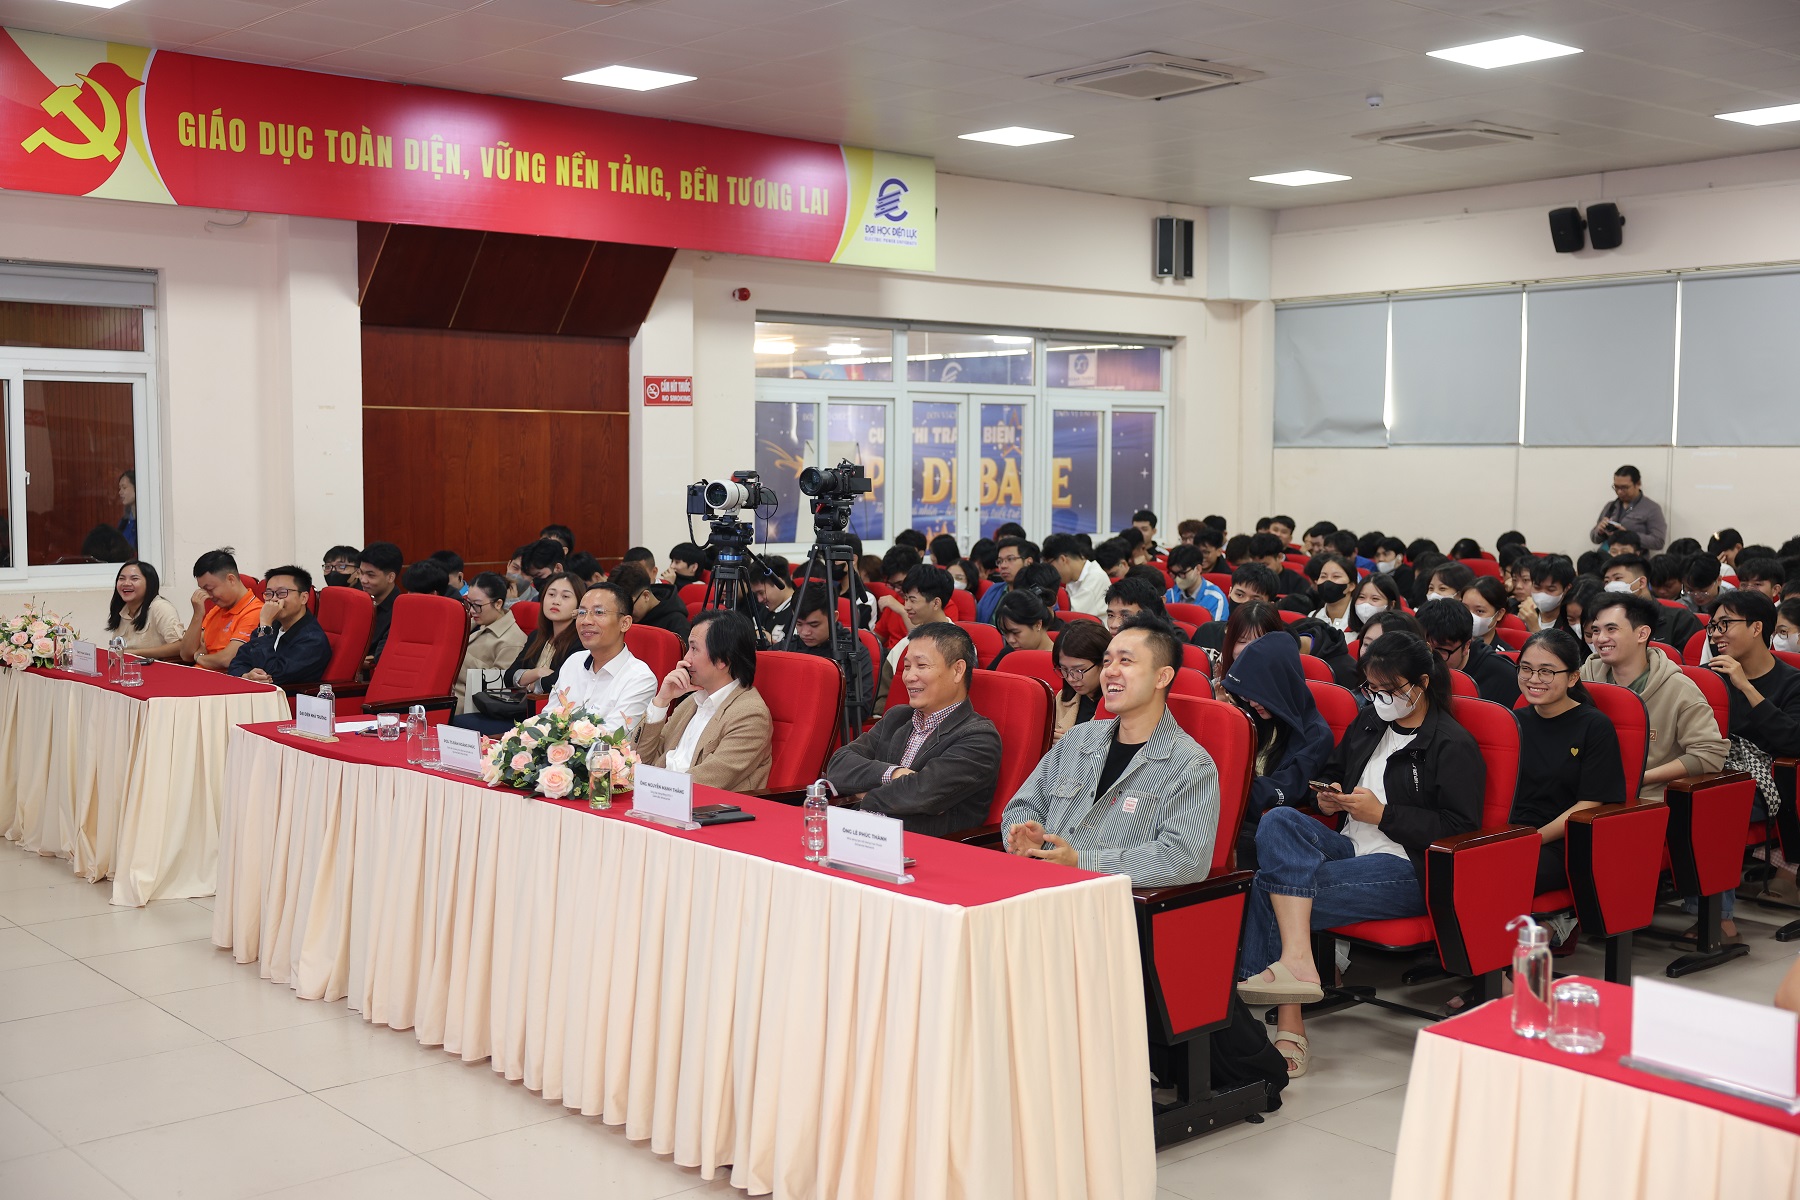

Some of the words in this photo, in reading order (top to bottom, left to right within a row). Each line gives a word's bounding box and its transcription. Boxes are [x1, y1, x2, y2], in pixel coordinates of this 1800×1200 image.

[178, 107, 246, 153] GIÁO
[259, 121, 314, 165] DỤC
[324, 125, 393, 168] TOÀN
[404, 134, 470, 180] DIỆN,
[480, 140, 546, 184] VỮNG
[556, 150, 599, 190] NỀN
[608, 153, 671, 201] TẢNG,
[680, 165, 719, 203] BỀN
[727, 176, 792, 212] TƯƠNG
[800, 186, 829, 216] LAI
